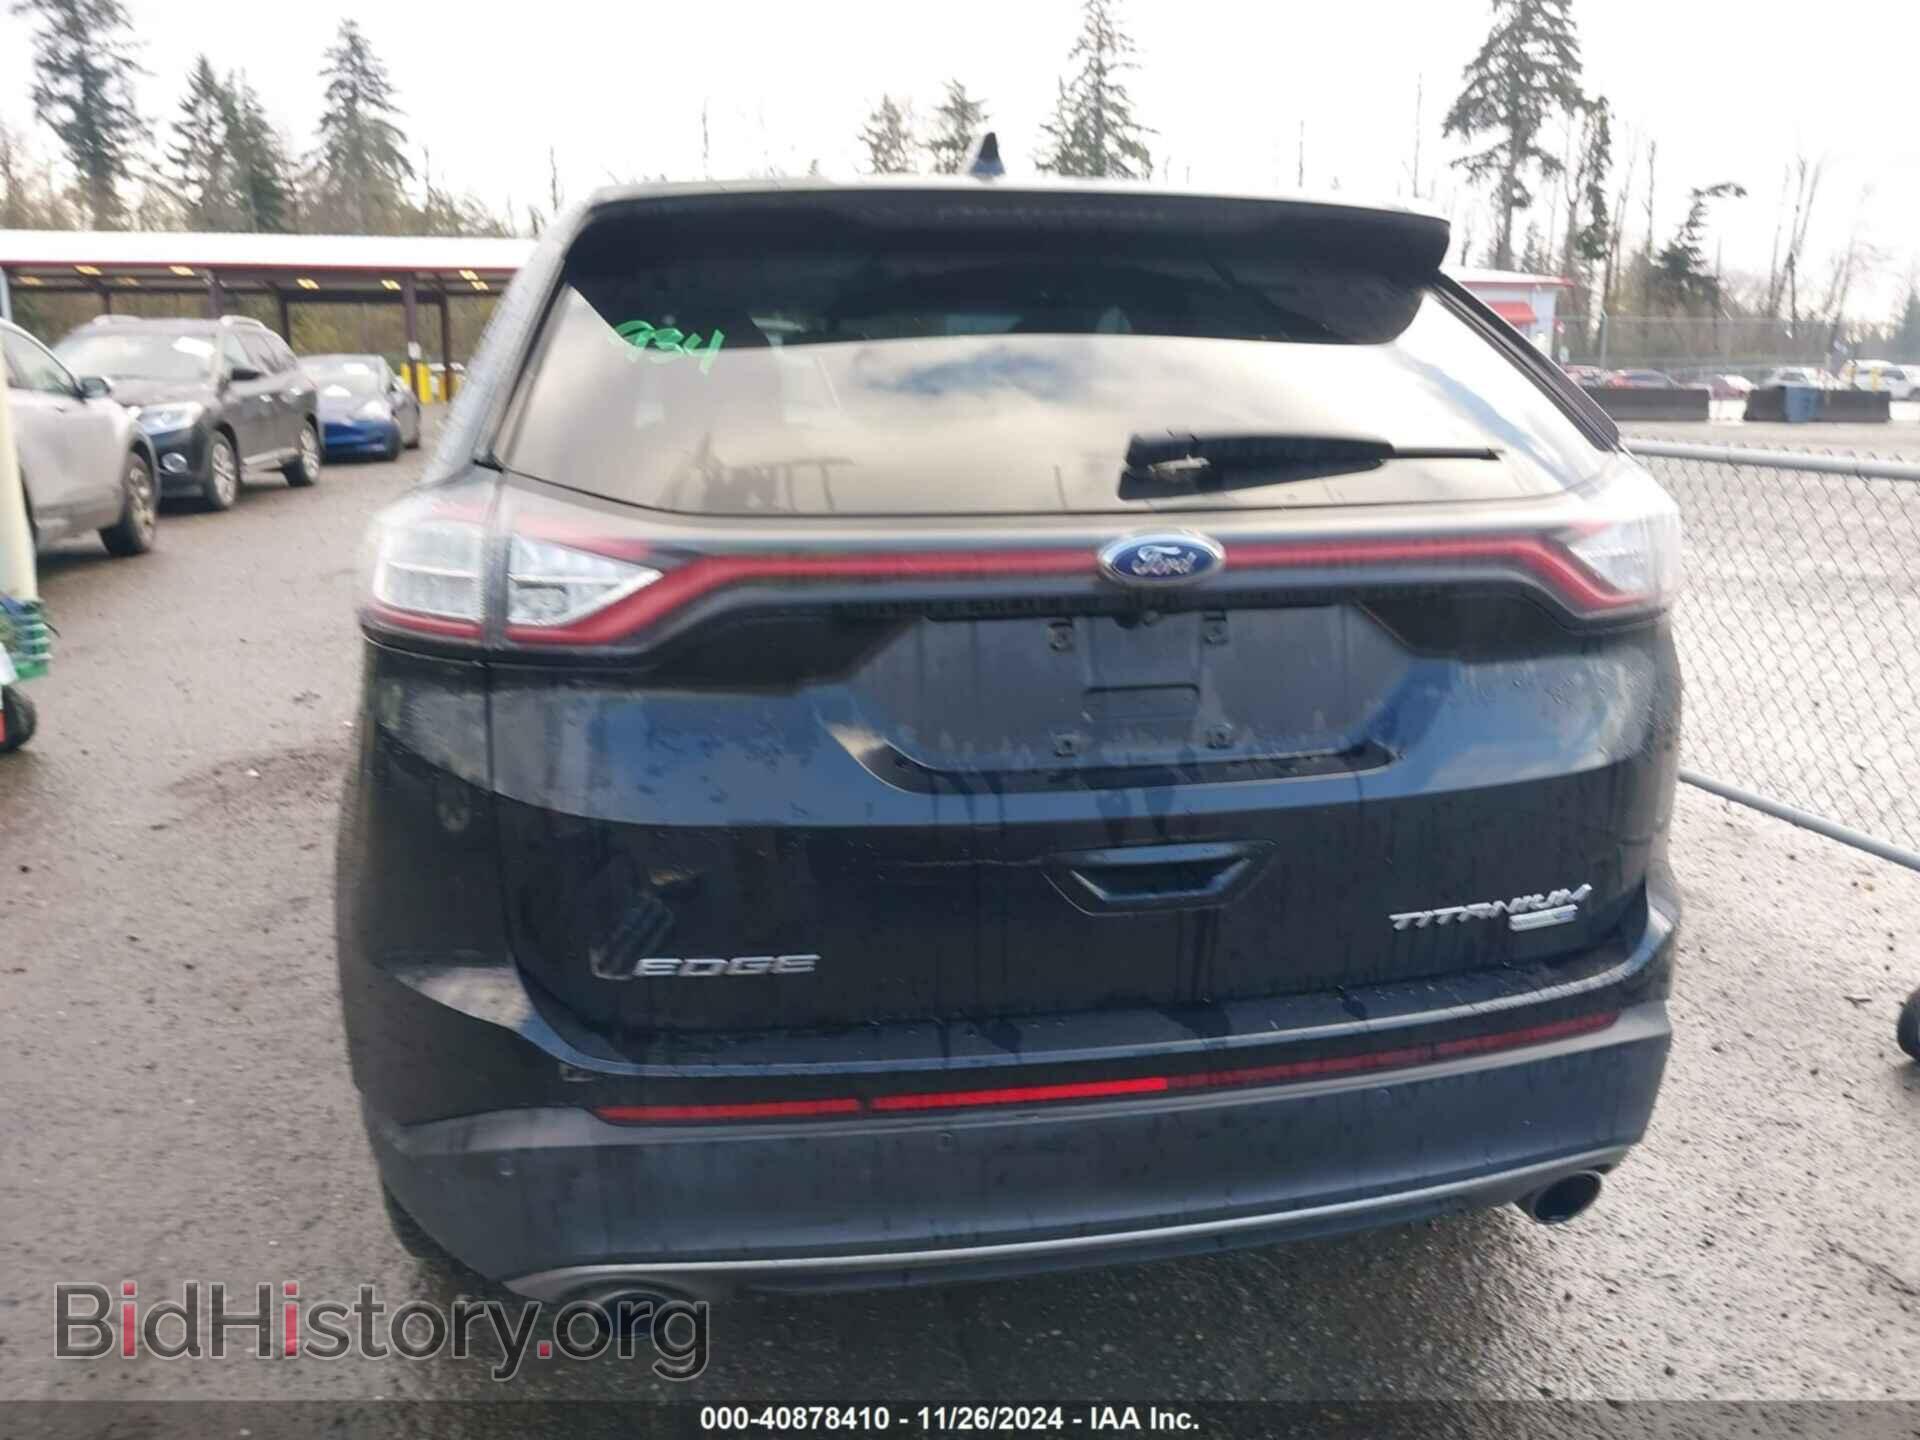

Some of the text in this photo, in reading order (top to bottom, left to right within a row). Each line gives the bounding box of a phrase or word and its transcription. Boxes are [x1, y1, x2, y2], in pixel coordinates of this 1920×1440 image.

[1131, 545, 1197, 576] Ford
[1388, 882, 1593, 931] TITANIUM
[633, 954, 822, 977] EDGE
